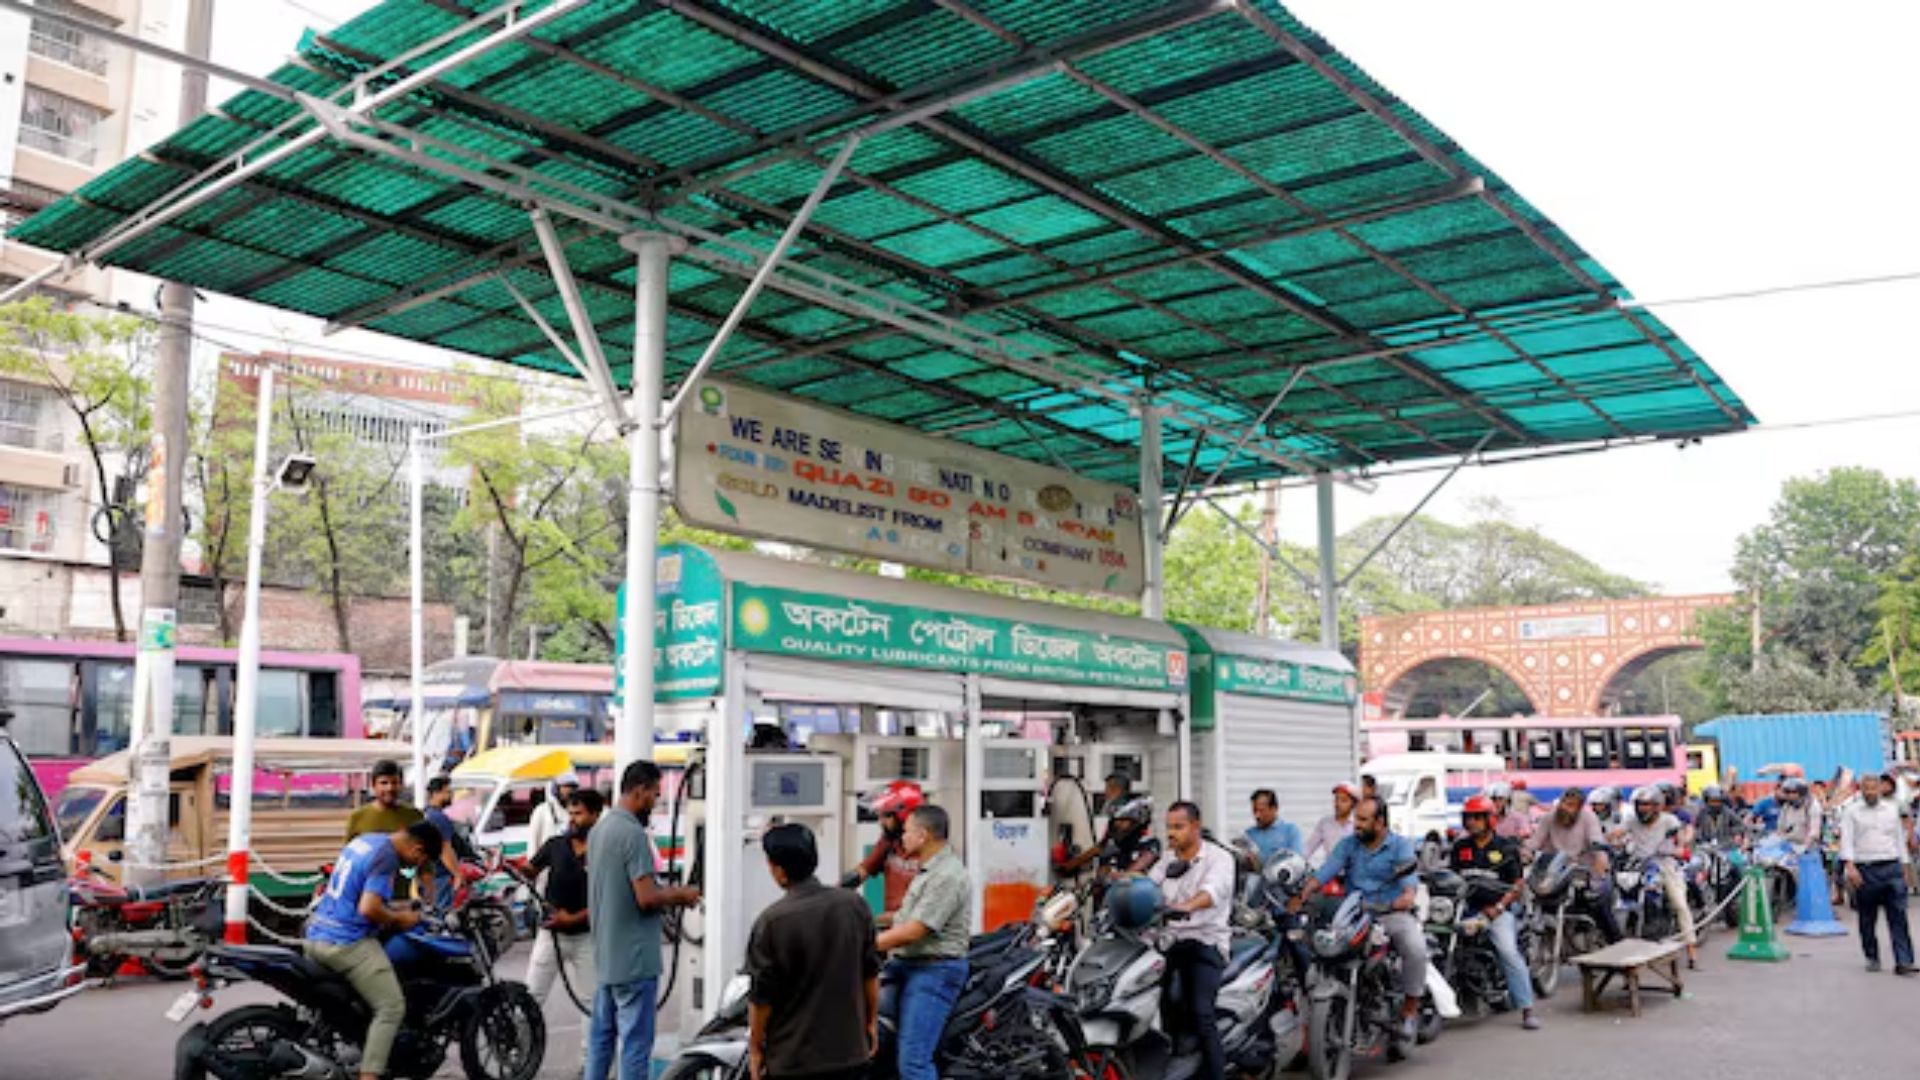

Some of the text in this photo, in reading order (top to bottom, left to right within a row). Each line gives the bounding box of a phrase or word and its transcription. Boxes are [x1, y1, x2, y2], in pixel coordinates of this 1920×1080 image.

[730, 416, 763, 443] WE
[771, 427, 811, 455] ARE
[792, 457, 896, 498] QUAZI
[717, 471, 778, 498] GOLD
[892, 508, 942, 533] FROM
[781, 601, 891, 642] অকটেন
[780, 635, 866, 656] QUALITY
[871, 646, 980, 669] LUBRICANTS
[984, 659, 1029, 674] FROM
[1033, 664, 1085, 681] BRITISH
